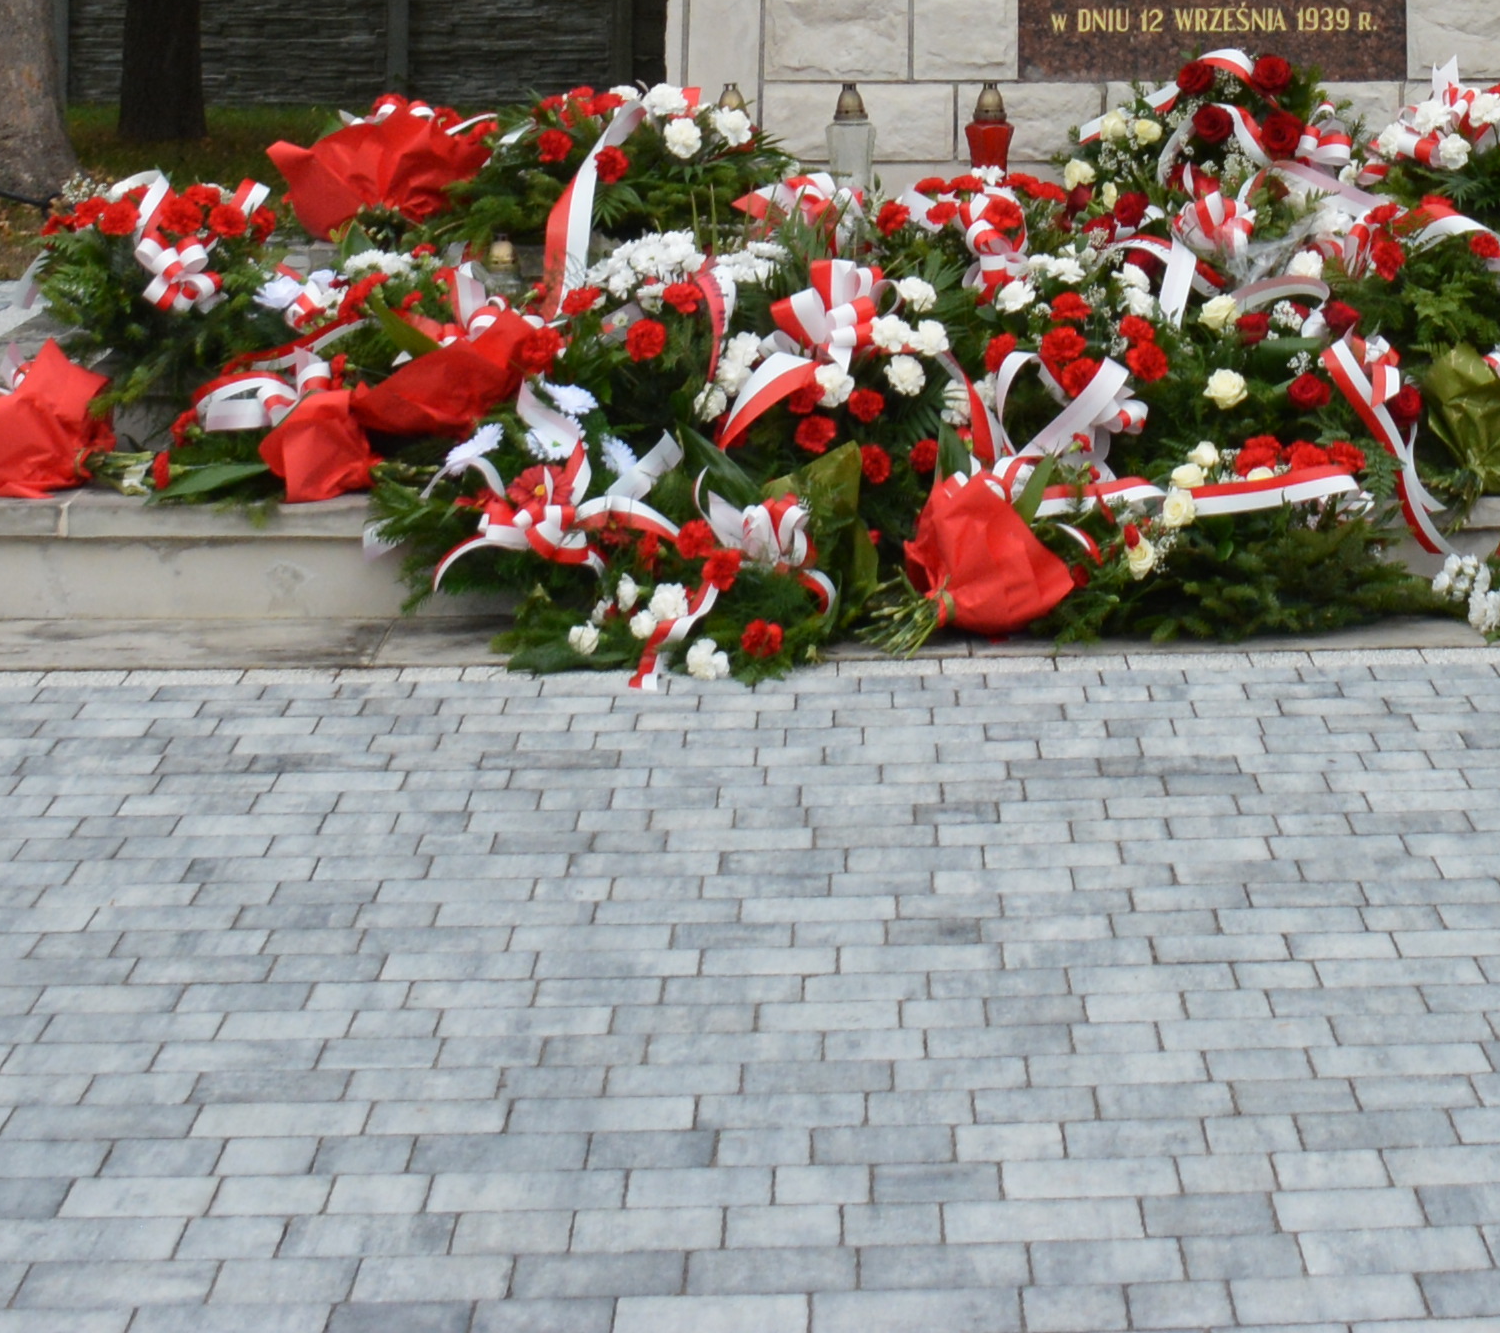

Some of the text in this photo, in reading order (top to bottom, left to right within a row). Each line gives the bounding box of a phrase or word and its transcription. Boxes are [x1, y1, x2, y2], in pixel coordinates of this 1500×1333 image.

[1077, 8, 1130, 32] DNIU
[1140, 9, 1164, 32] 12
[1174, 2, 1287, 32] WRZEŚNIA
[1297, 7, 1350, 32] 1939
